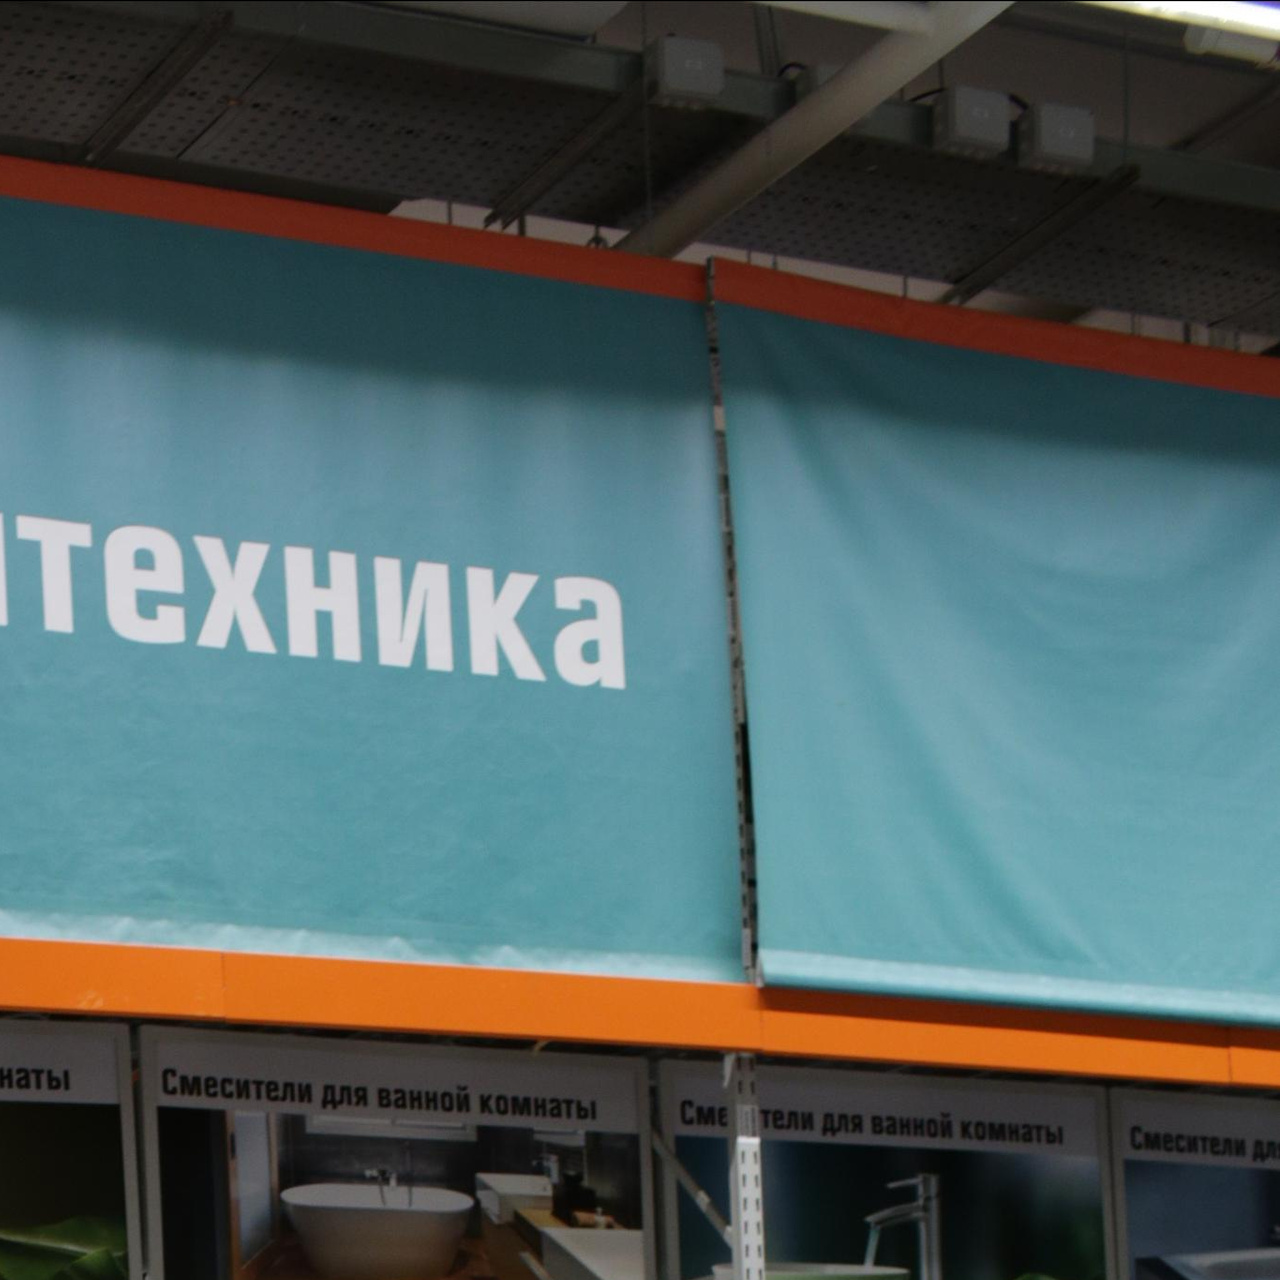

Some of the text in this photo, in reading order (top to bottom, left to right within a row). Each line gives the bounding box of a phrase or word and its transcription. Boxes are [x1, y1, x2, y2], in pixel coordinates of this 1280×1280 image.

[162, 1068, 596, 1121] Смесители для ванной комнаты
[681, 1100, 1064, 1145] Сметели для ванной комнаты
[1130, 1125, 1246, 1157] Смесители
